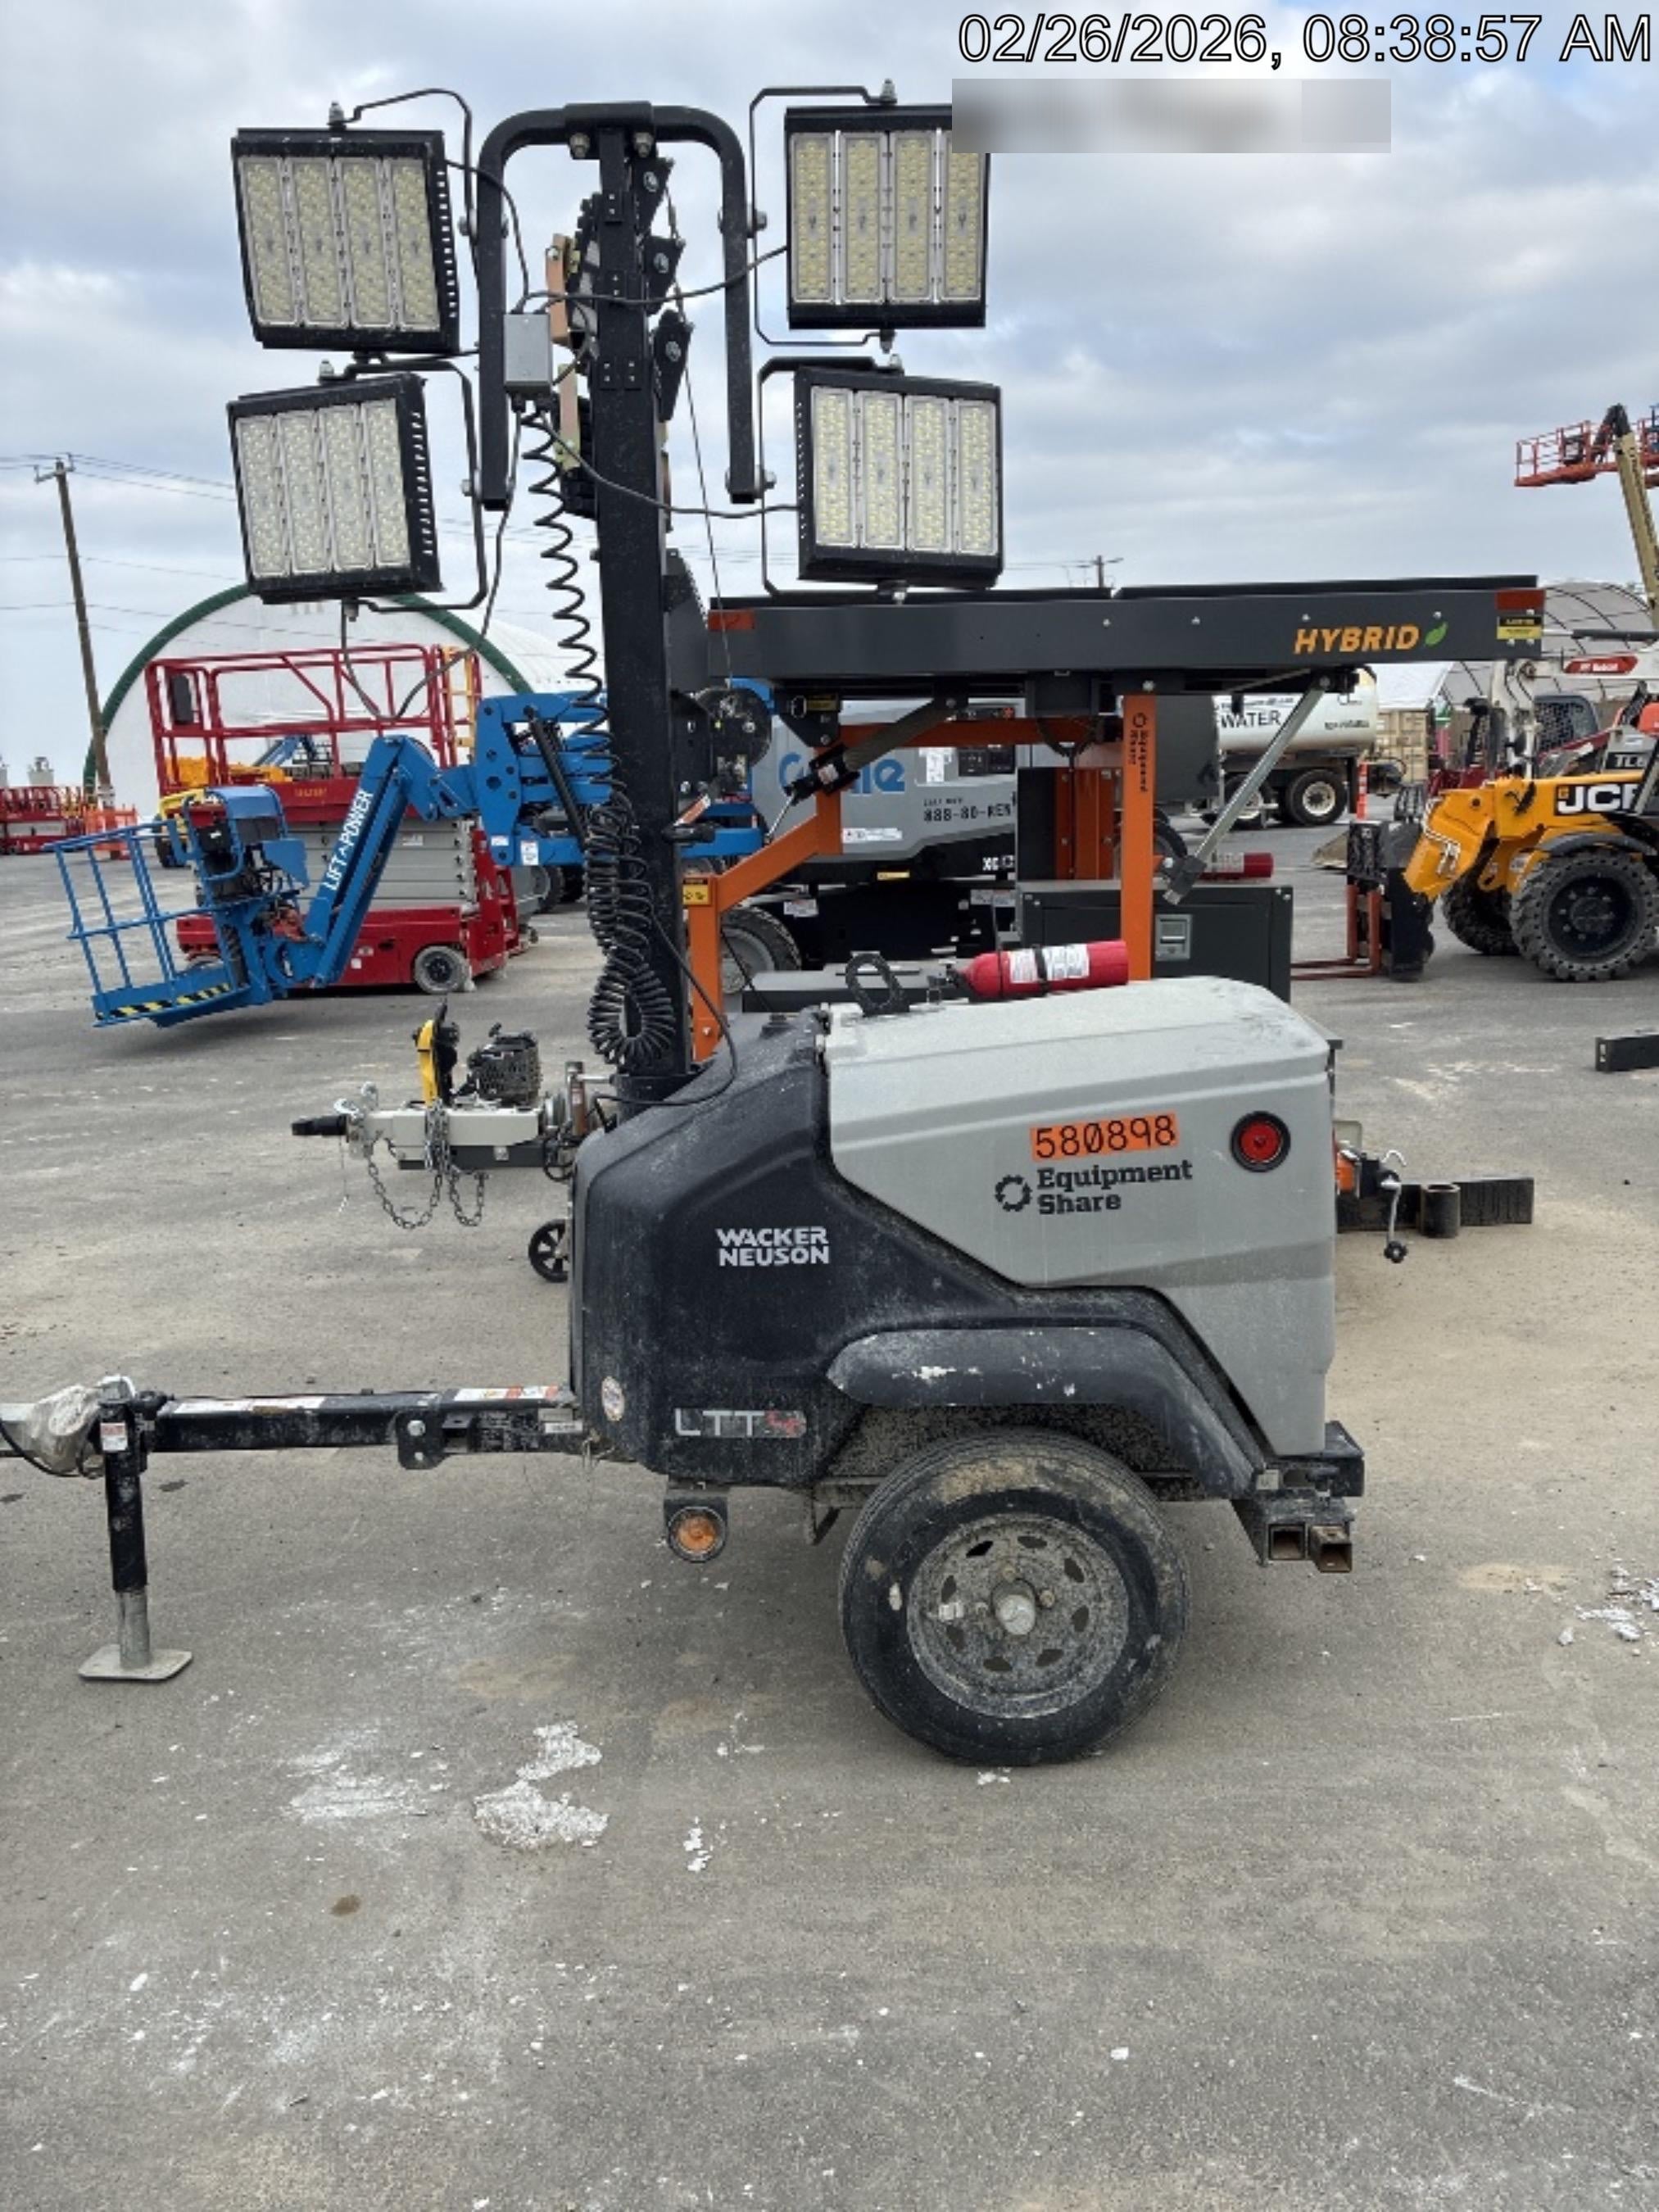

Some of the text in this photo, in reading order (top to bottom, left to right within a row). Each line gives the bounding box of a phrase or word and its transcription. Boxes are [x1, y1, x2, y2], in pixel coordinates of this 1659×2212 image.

[1294, 623, 1420, 655] HYBRID
[1220, 709, 1282, 728] WATER
[321, 789, 374, 891] LIFT POWER
[1036, 1115, 1176, 1158] 580898
[1036, 1159, 1193, 1192] Equipment
[1037, 1194, 1122, 1214] Share
[715, 1226, 829, 1247] WACKER
[718, 1245, 830, 1267] NEUSON
